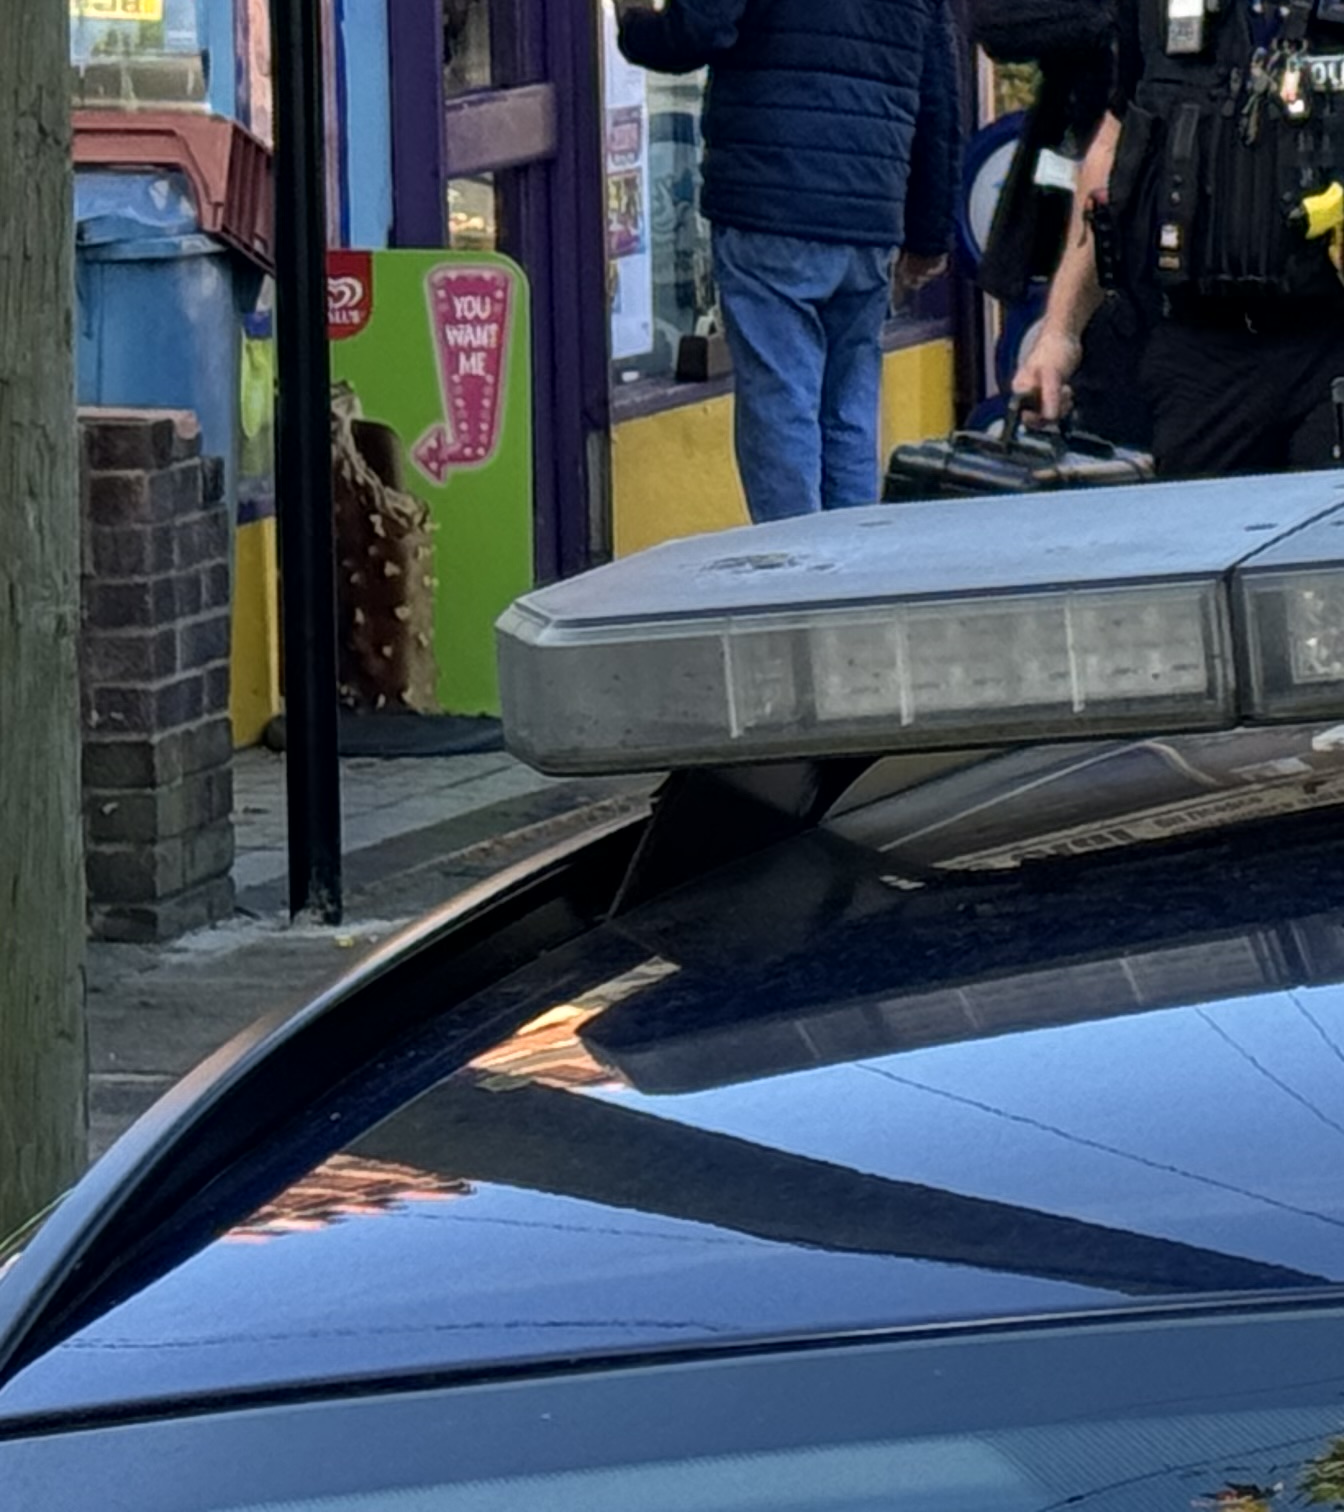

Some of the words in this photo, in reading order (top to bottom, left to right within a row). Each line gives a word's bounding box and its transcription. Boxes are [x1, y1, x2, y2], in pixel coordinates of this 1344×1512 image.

[452, 294, 491, 321] YOU
[444, 322, 498, 349] WANT
[459, 350, 487, 376] ME
